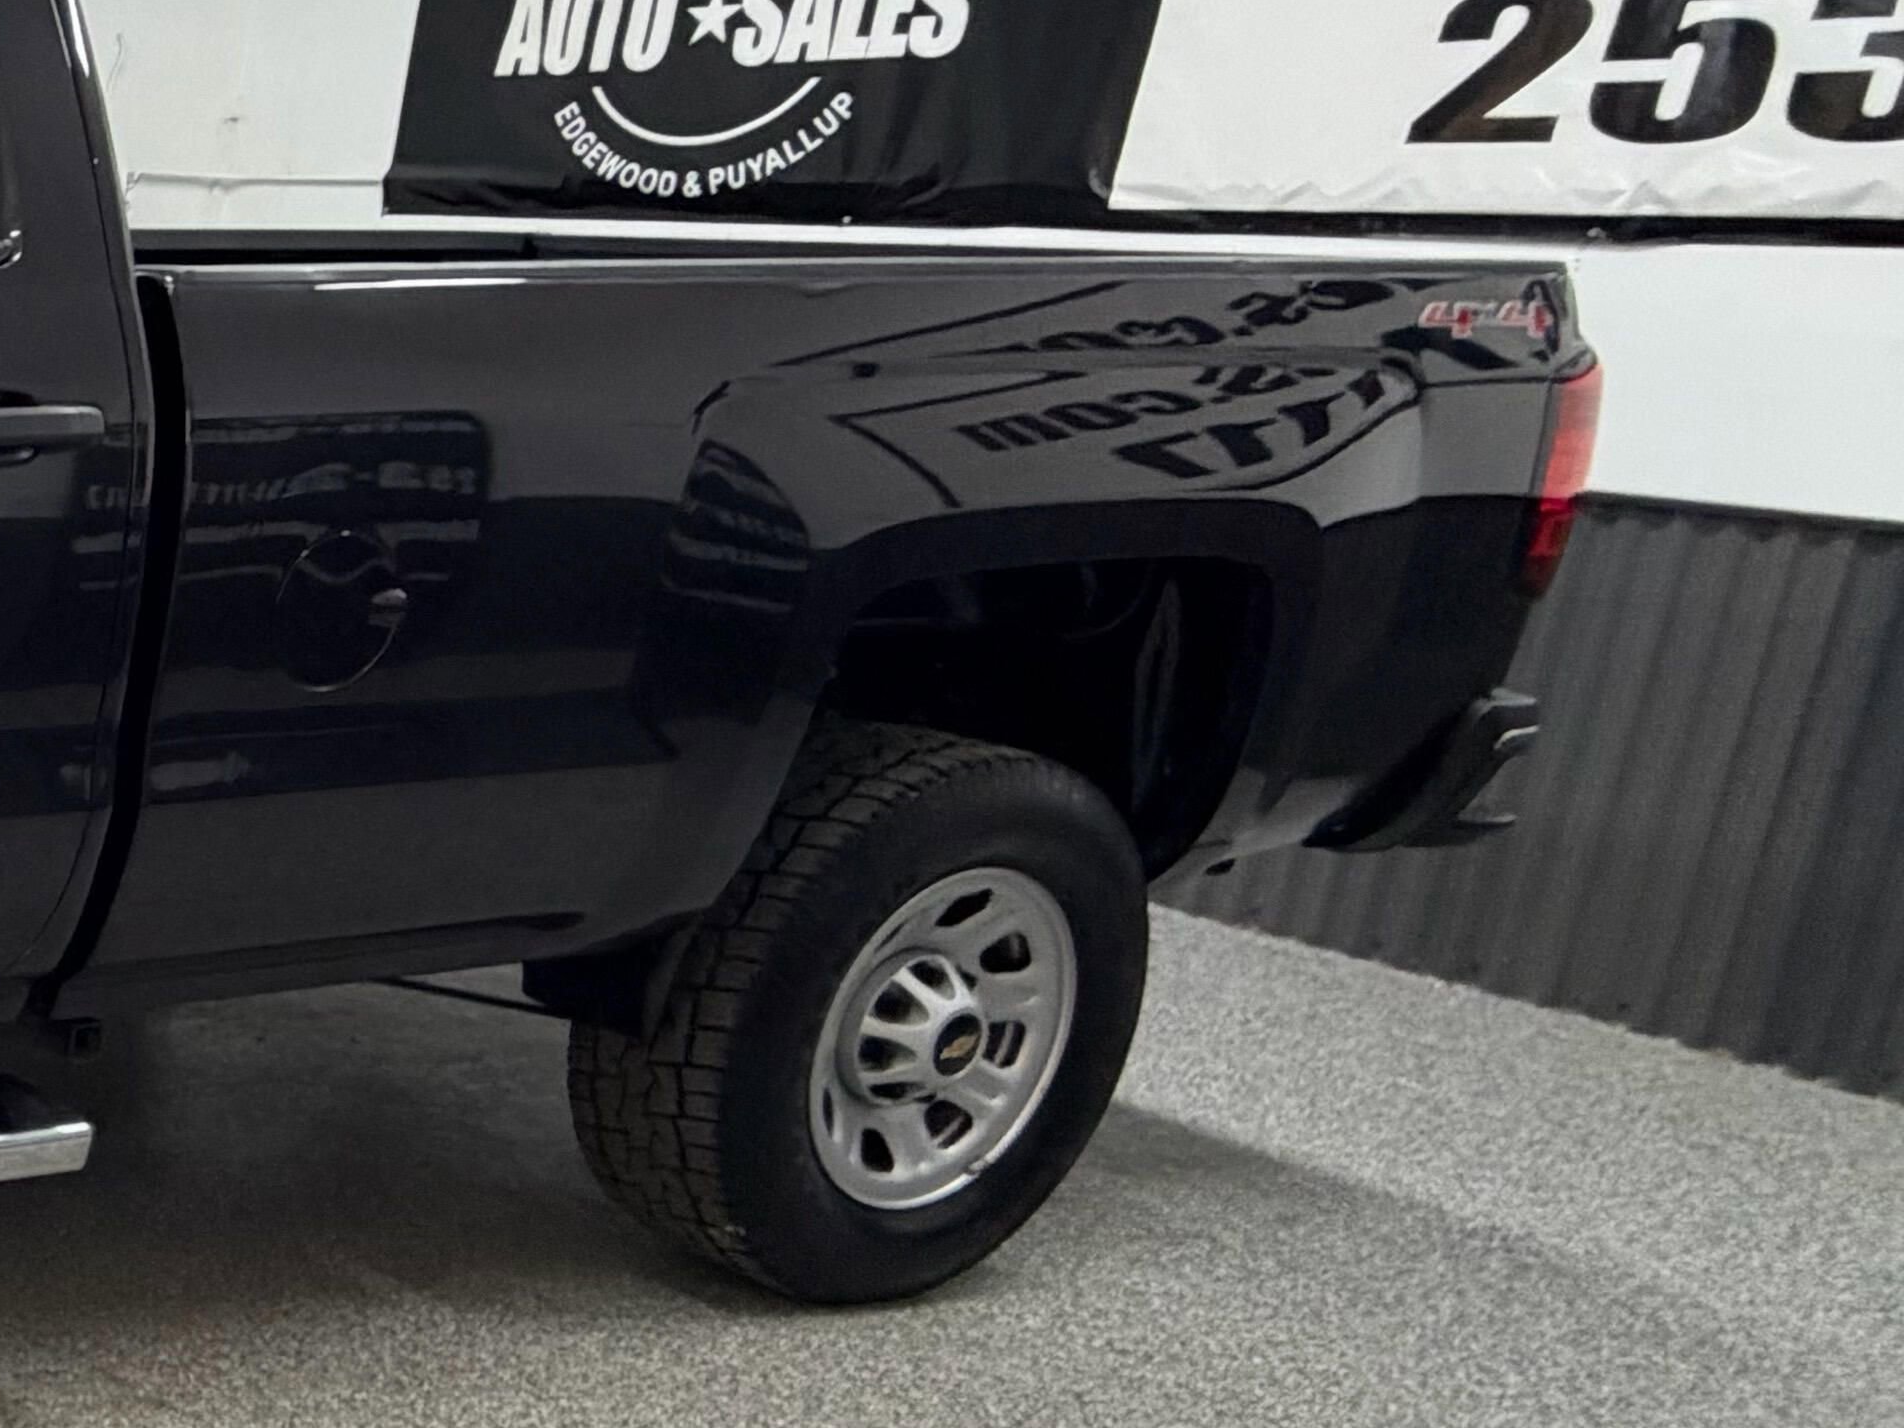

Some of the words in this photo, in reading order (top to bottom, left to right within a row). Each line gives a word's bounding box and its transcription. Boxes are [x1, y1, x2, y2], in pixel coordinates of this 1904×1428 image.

[553, 100, 679, 198] EDGEWOOD
[680, 170, 704, 199] &
[707, 90, 855, 197] PUYALLUP
